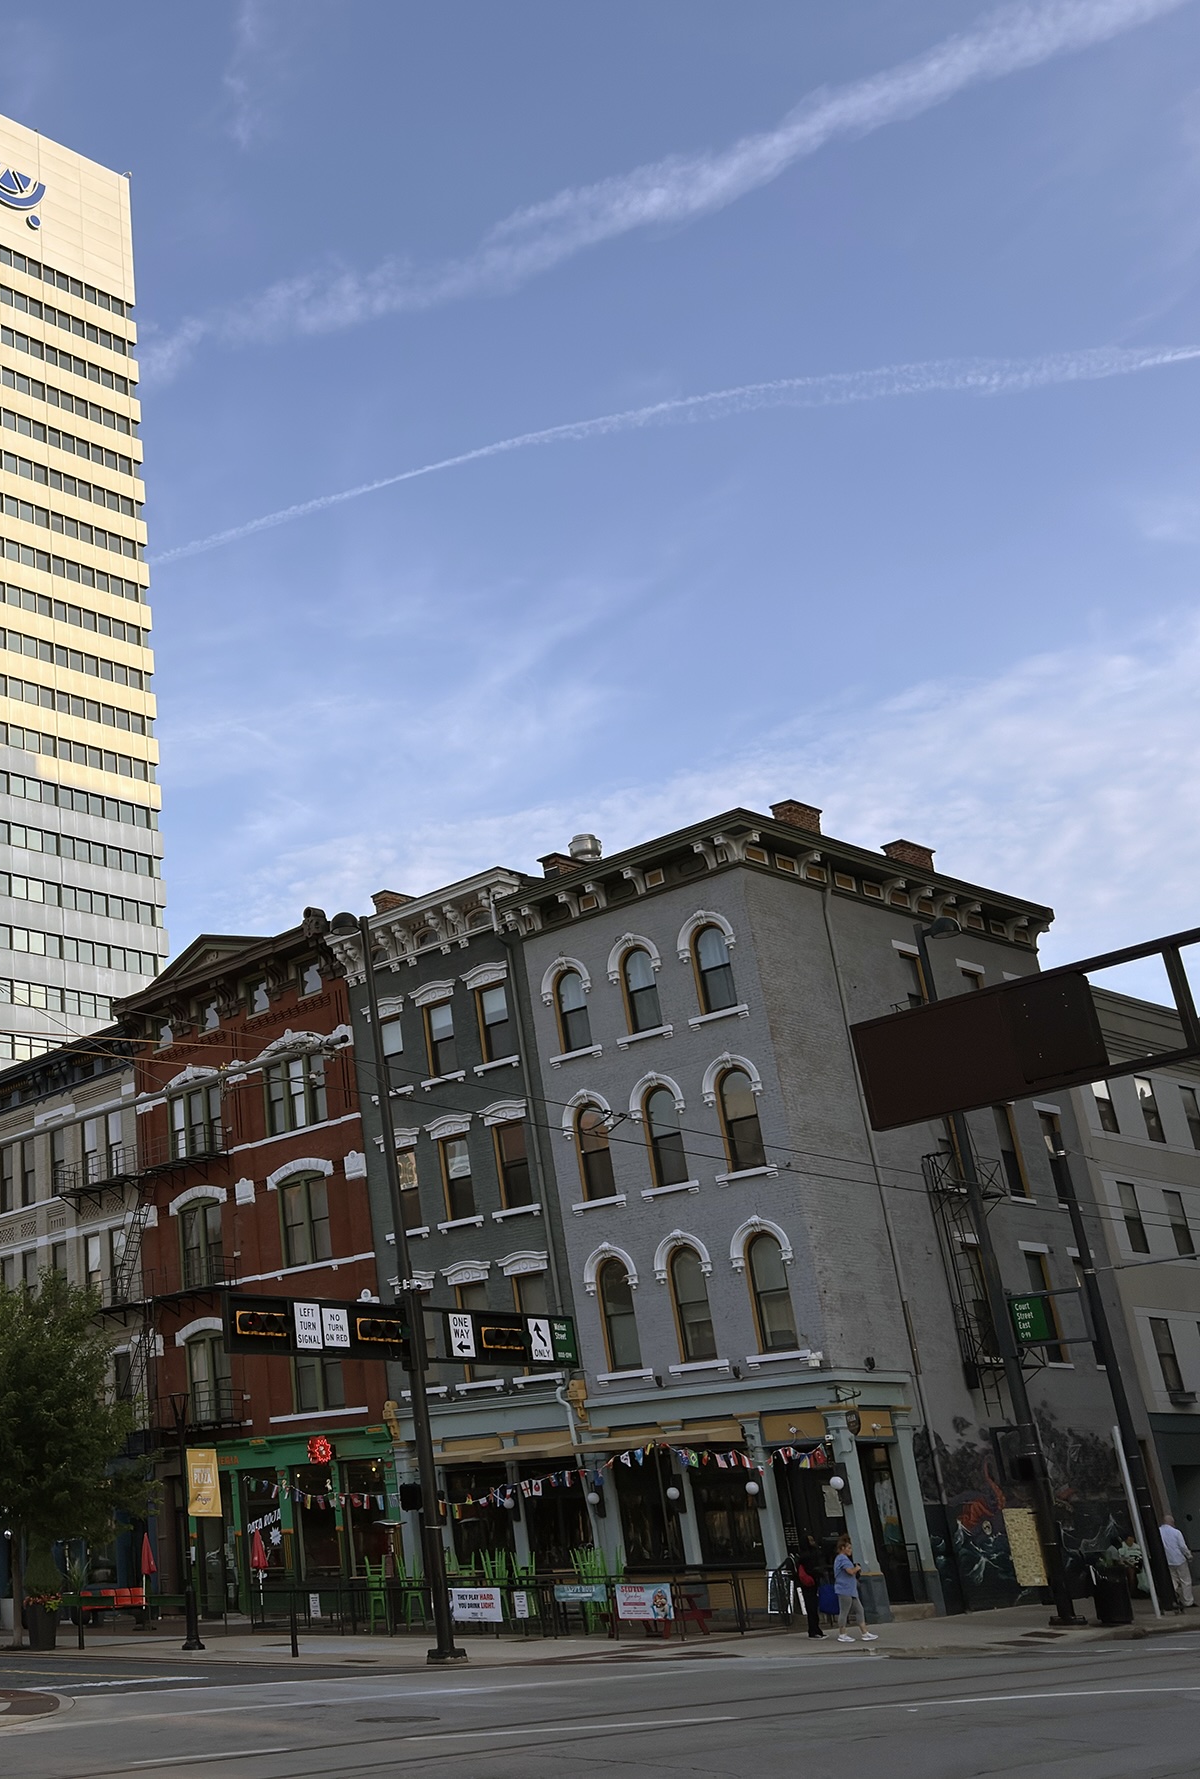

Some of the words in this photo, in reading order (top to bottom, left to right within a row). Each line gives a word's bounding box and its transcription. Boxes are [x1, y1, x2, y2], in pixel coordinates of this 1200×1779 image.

[1014, 1302, 1031, 1311] Court
[299, 1307, 314, 1318] LEFT
[329, 1313, 341, 1322] NO
[1016, 1311, 1034, 1320] Street
[299, 1321, 317, 1331] TURN
[452, 1316, 469, 1328] ONE
[1018, 1321, 1031, 1330] East
[328, 1324, 344, 1332] TURN
[325, 1333, 335, 1342] ON
[336, 1334, 349, 1343] RED
[453, 1328, 470, 1339] WAY
[554, 1331, 568, 1340] Street
[297, 1334, 321, 1345] SIGNAL
[534, 1348, 551, 1358] ONLY
[246, 1517, 263, 1535] PATA
[263, 1507, 281, 1528] ROJA
[479, 1593, 495, 1601] HARD.
